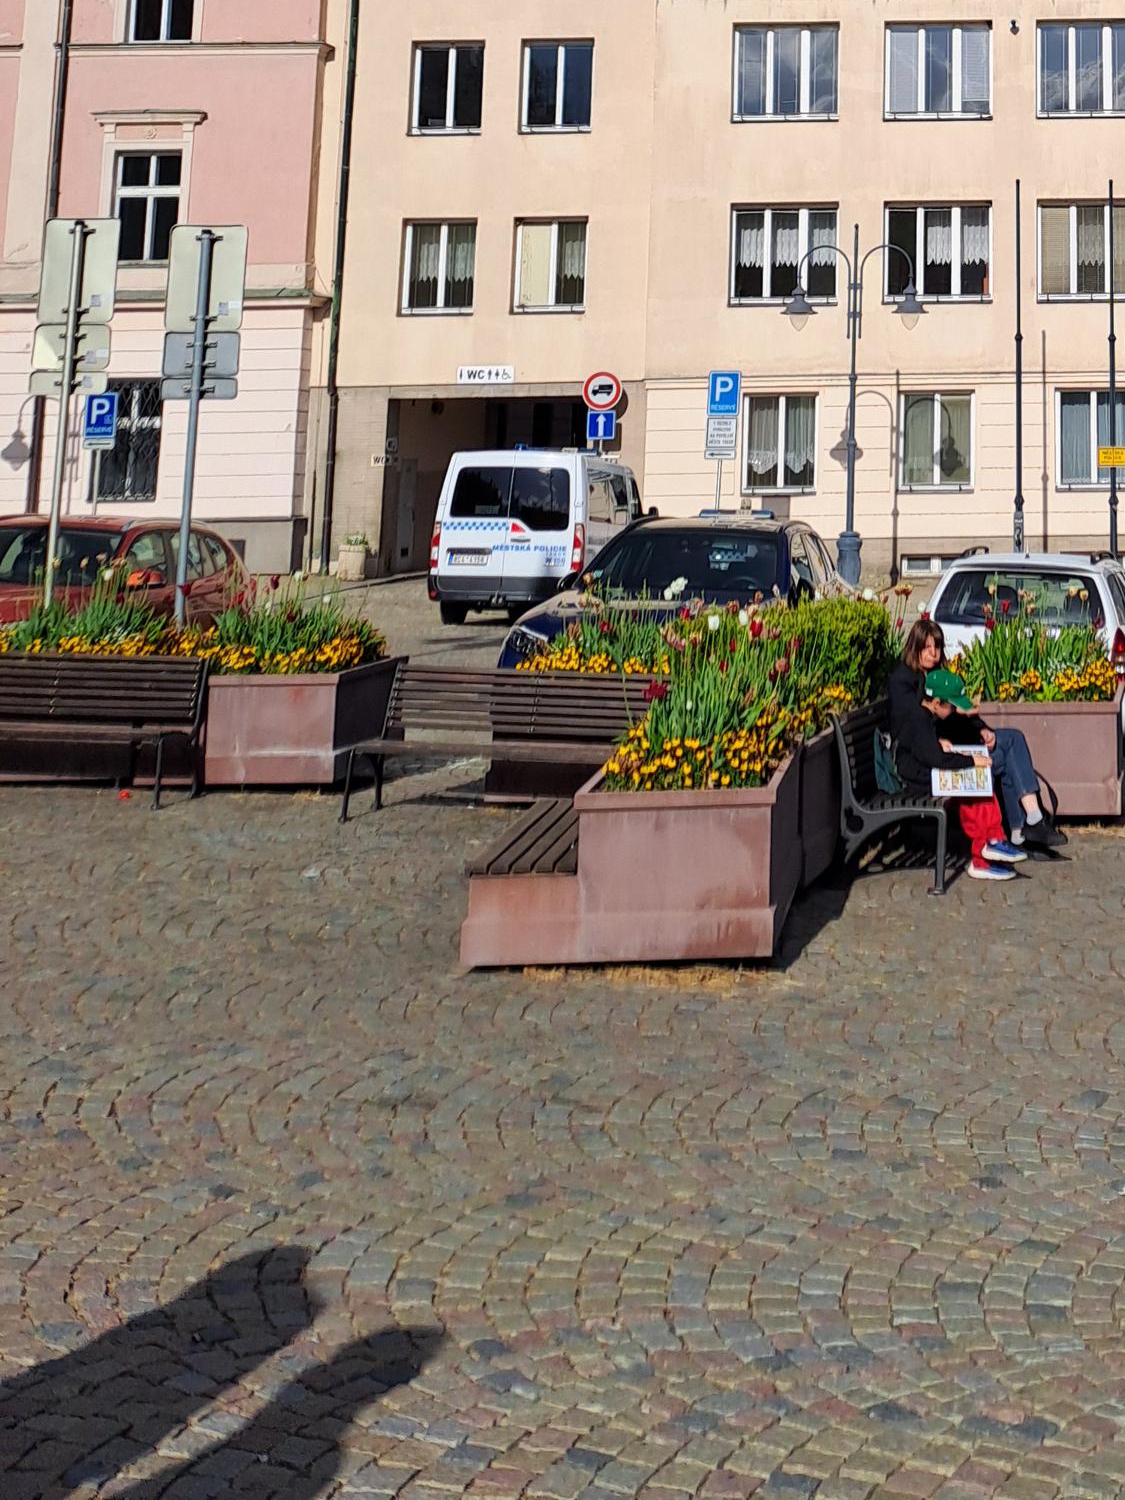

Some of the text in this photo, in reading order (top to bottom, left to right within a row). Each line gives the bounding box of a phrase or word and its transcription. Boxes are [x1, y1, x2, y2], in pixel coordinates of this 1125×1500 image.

[467, 369, 485, 380] WC
[715, 376, 734, 402] P
[90, 398, 110, 425] P
[492, 543, 531, 552] MĚSTSKÁ
